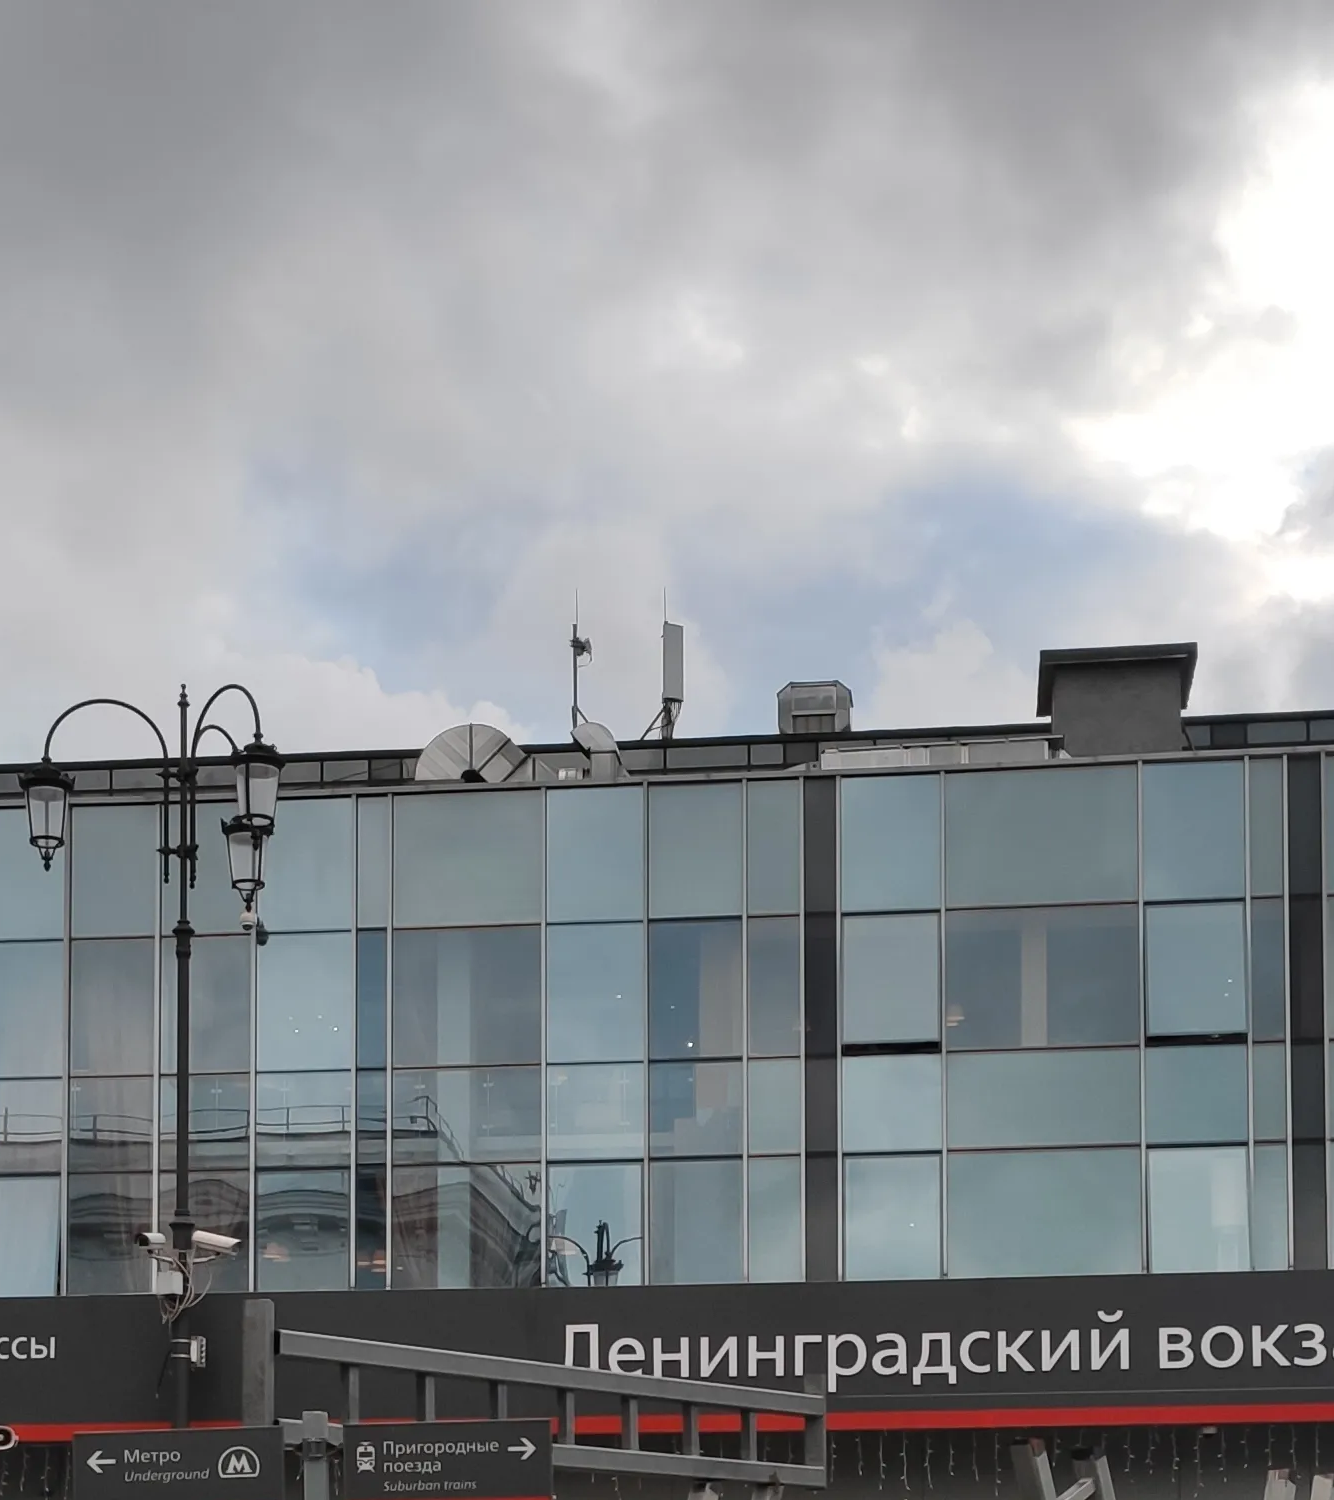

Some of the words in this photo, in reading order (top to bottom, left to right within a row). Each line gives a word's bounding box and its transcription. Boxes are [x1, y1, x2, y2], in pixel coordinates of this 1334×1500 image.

[564, 1310, 1130, 1393] Ленинградский
[123, 1449, 181, 1466] Метро
[383, 1440, 500, 1460] Пригородные
[124, 1467, 211, 1484] Underground
[383, 1459, 442, 1475] поезда
[383, 1480, 441, 1492] Suburban
[444, 1480, 478, 1491] trains
